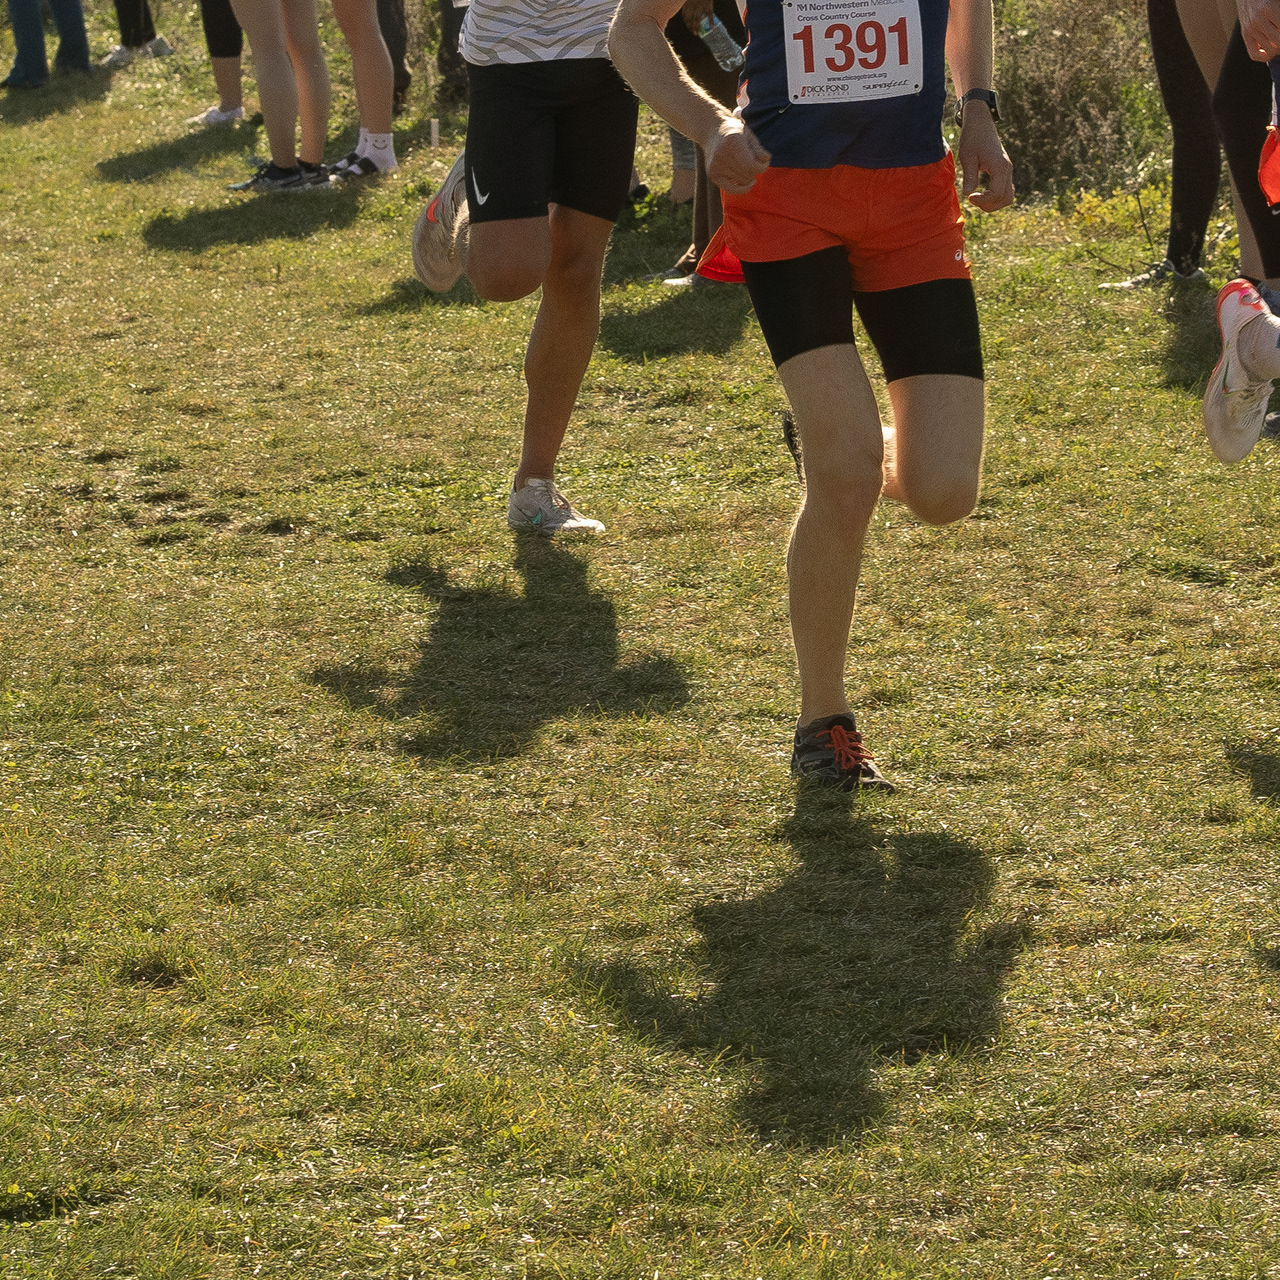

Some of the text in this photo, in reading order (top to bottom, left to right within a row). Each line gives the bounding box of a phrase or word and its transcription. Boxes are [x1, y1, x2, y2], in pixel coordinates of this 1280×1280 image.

[809, 0, 869, 11] Northwestern
[820, 13, 850, 22] Country
[850, 10, 876, 19] Course
[793, 16, 909, 73] 1391
[827, 72, 888, 82] www.chicagotrack.org
[807, 83, 850, 93] DICK POND
